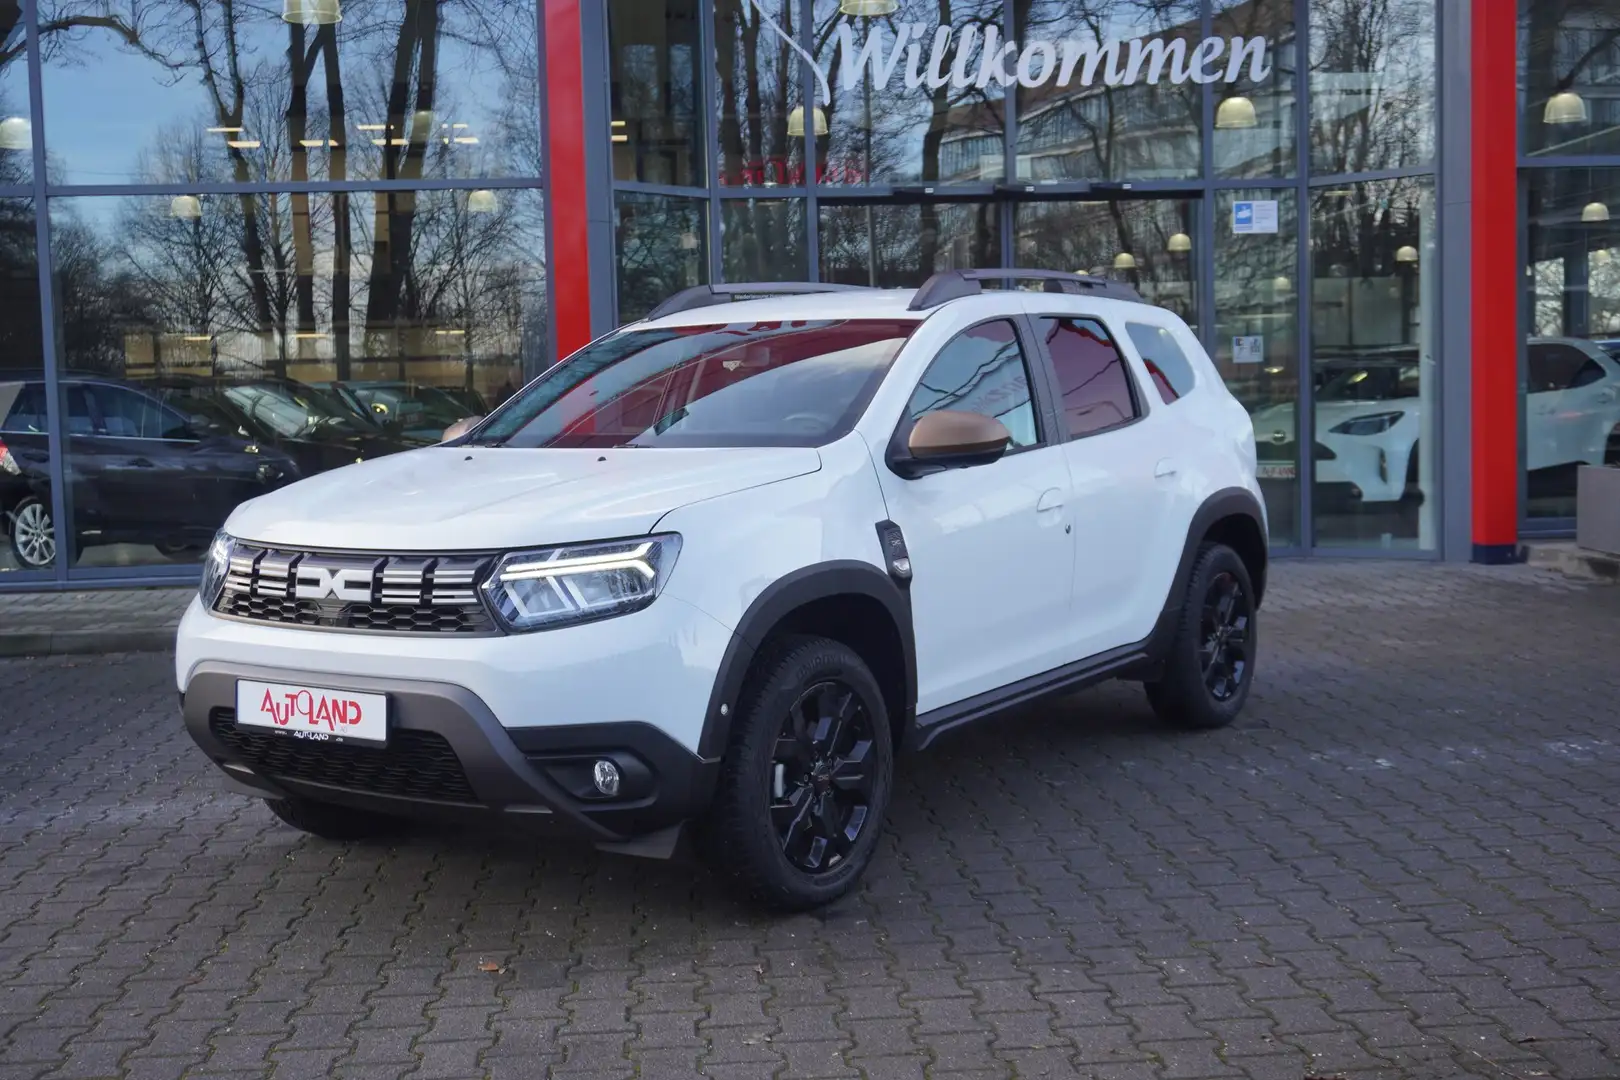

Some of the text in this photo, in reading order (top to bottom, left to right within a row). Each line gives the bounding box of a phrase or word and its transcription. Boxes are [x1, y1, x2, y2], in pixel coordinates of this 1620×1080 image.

[837, 21, 1272, 90] Willkommen
[260, 688, 362, 731] AUTOLAND
[293, 730, 329, 741] AUTOLAND
